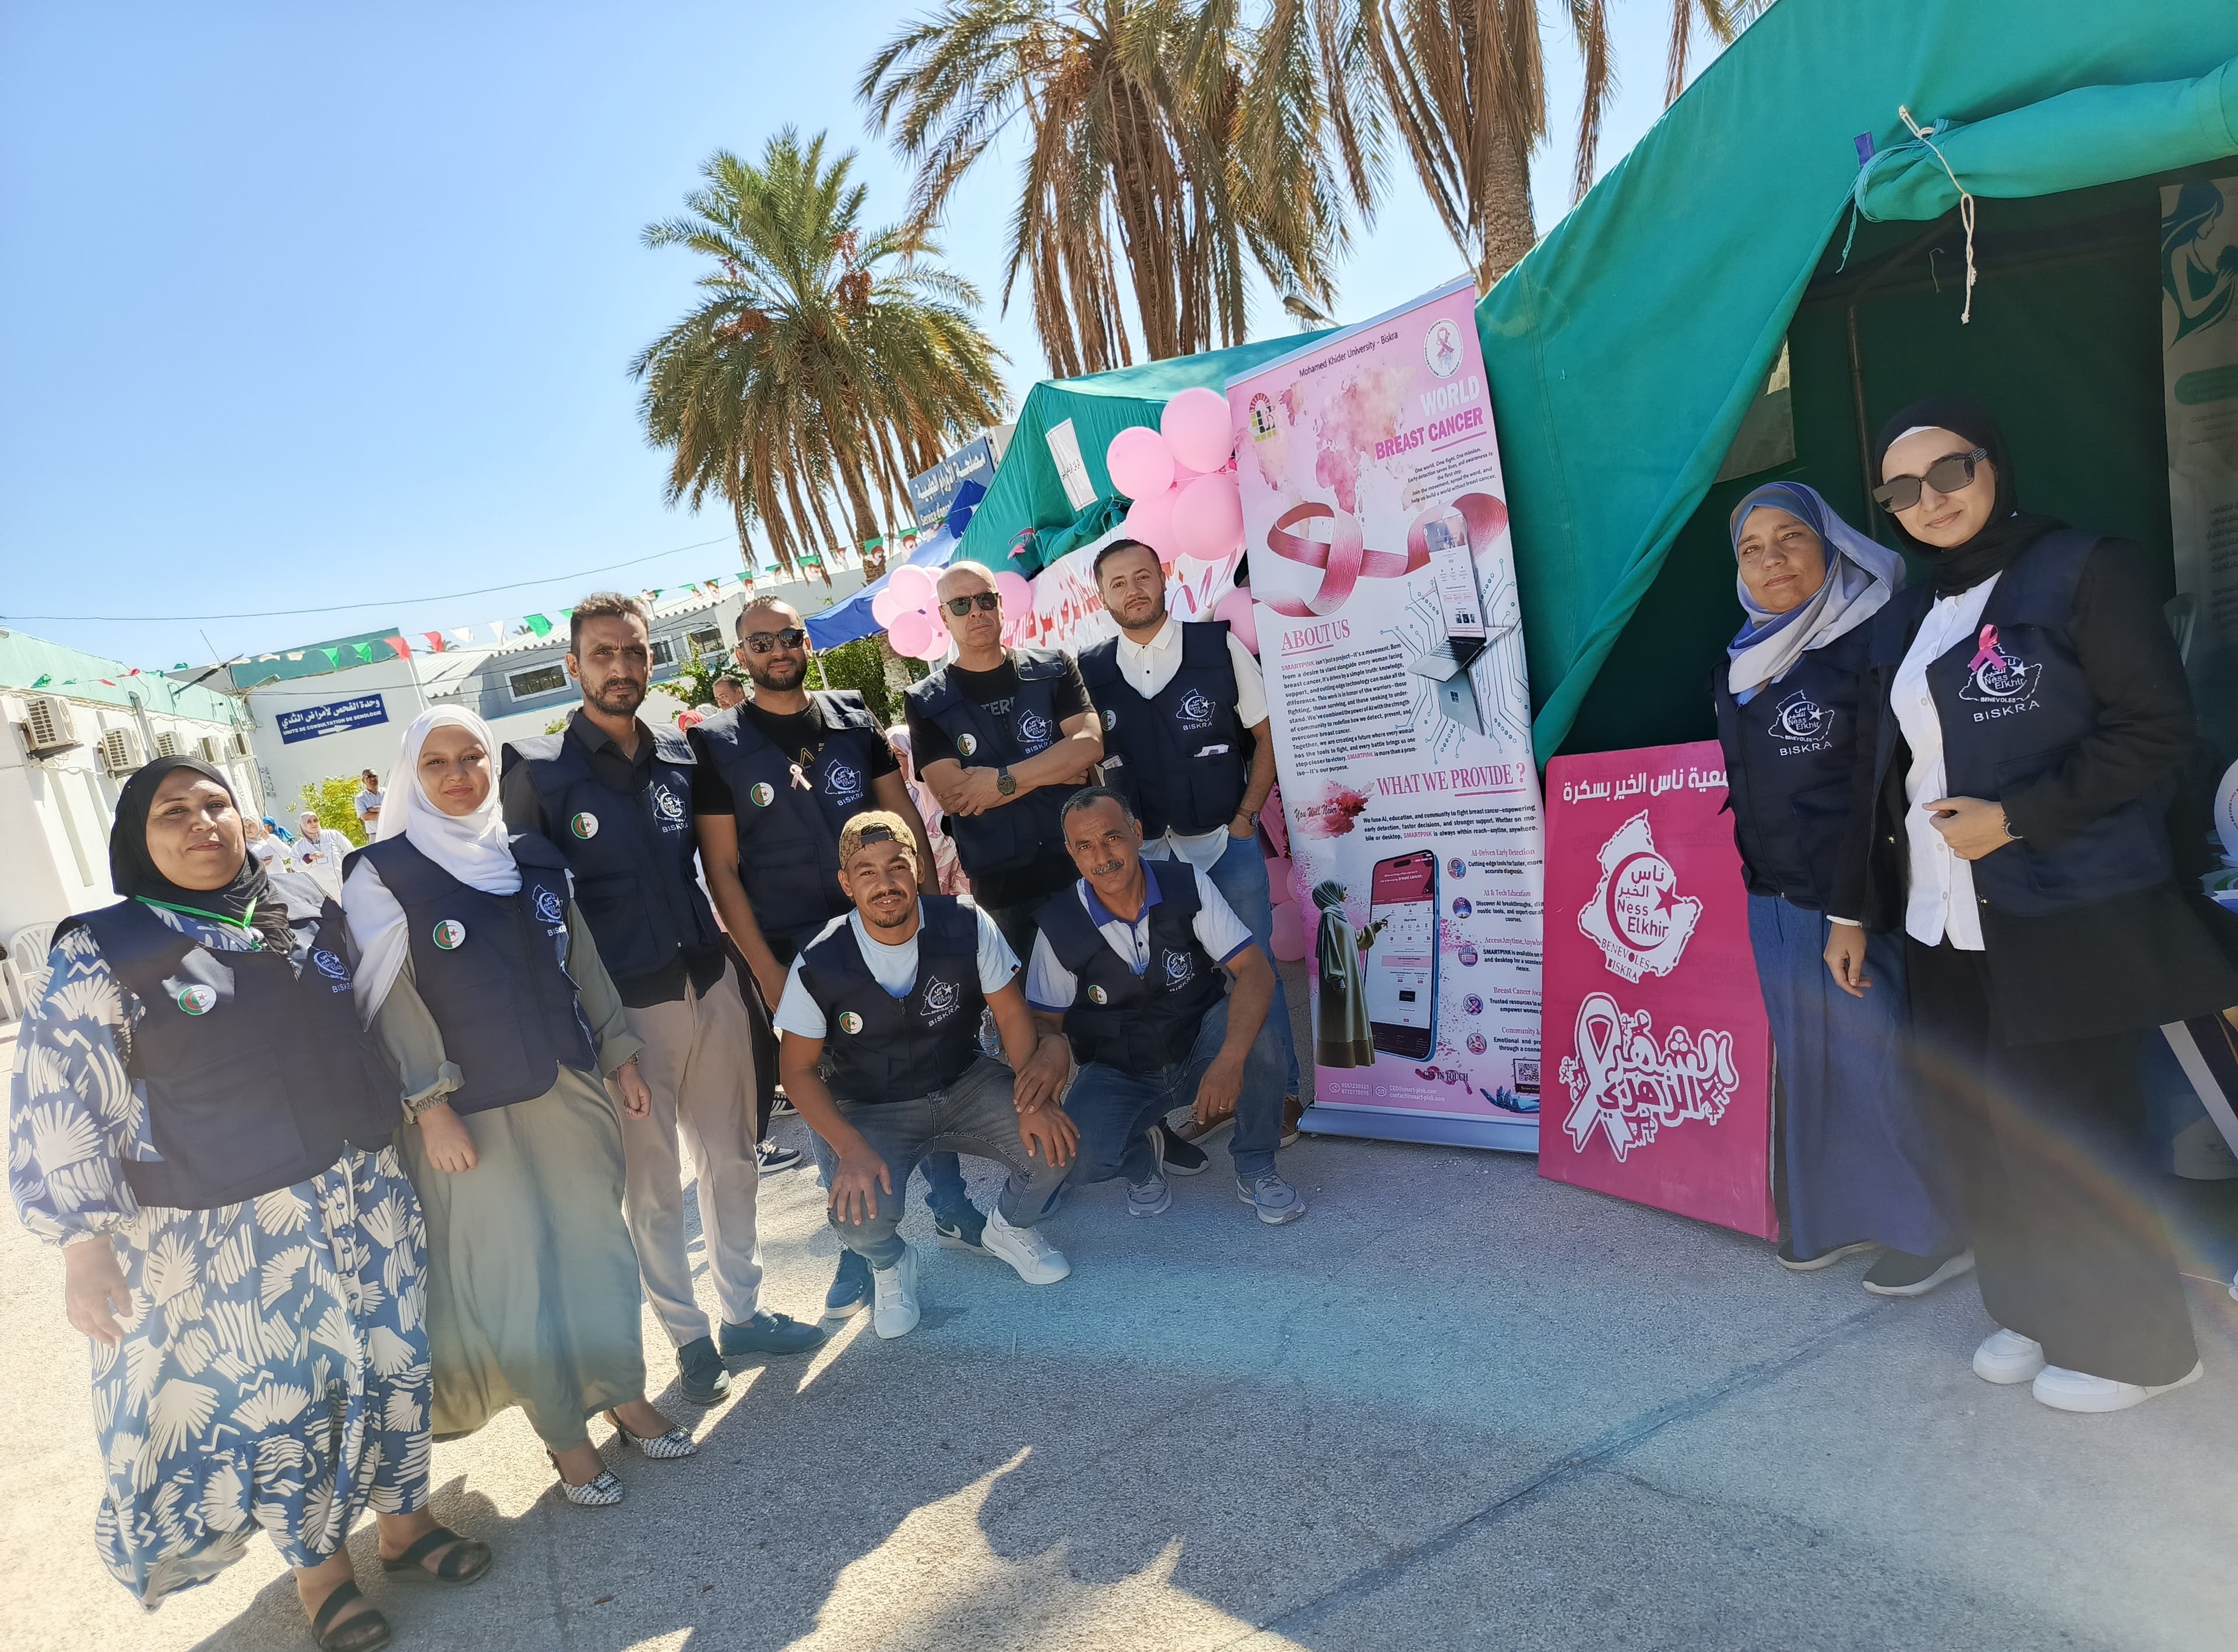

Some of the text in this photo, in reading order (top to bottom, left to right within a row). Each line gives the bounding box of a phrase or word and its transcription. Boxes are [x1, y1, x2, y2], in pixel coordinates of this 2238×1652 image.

[1299, 359, 1327, 377] Mohamed
[1328, 353, 1346, 365] Khider
[1347, 341, 1375, 358] University
[1380, 332, 1398, 344] Biskra
[1420, 375, 1480, 417] WORLD
[1375, 407, 1483, 460] BREAST CANCER
[920, 509, 937, 526] Service
[1282, 619, 1350, 650] ABOUT US
[1336, 661, 1357, 670] alongside
[1984, 675, 2008, 685] Ness
[333, 702, 359, 717] الفحص
[360, 699, 381, 709] وحدة
[1973, 700, 2039, 722] BISKRA
[281, 713, 304, 729] الثدي
[307, 718, 346, 730] CONSULTATION
[353, 710, 382, 720] SENOLOGIE
[1183, 721, 1212, 730] BISKRA
[1025, 740, 1053, 754] BISKRA
[1780, 741, 1832, 756] BISKRA
[1377, 763, 1525, 796] WHAT WE PROVIDE ?
[1563, 767, 1729, 804] معية ناس الخير بسكرة
[837, 792, 864, 806] BISKRA
[1294, 808, 1306, 822] You
[1307, 806, 1321, 816] Will
[1631, 865, 1664, 884] ناس
[1618, 885, 1649, 898] الخير
[1617, 899, 1649, 917] Ness
[1627, 917, 1669, 938] Elkhir
[1601, 938, 1650, 970] BENEVOLES
[1607, 958, 1638, 982] BISKRA
[928, 1005, 960, 1026] BISKRA
[1502, 1026, 1535, 1035] Community
[1437, 1072, 1444, 1080] IN
[1445, 1072, 1468, 1082] TOUCH
